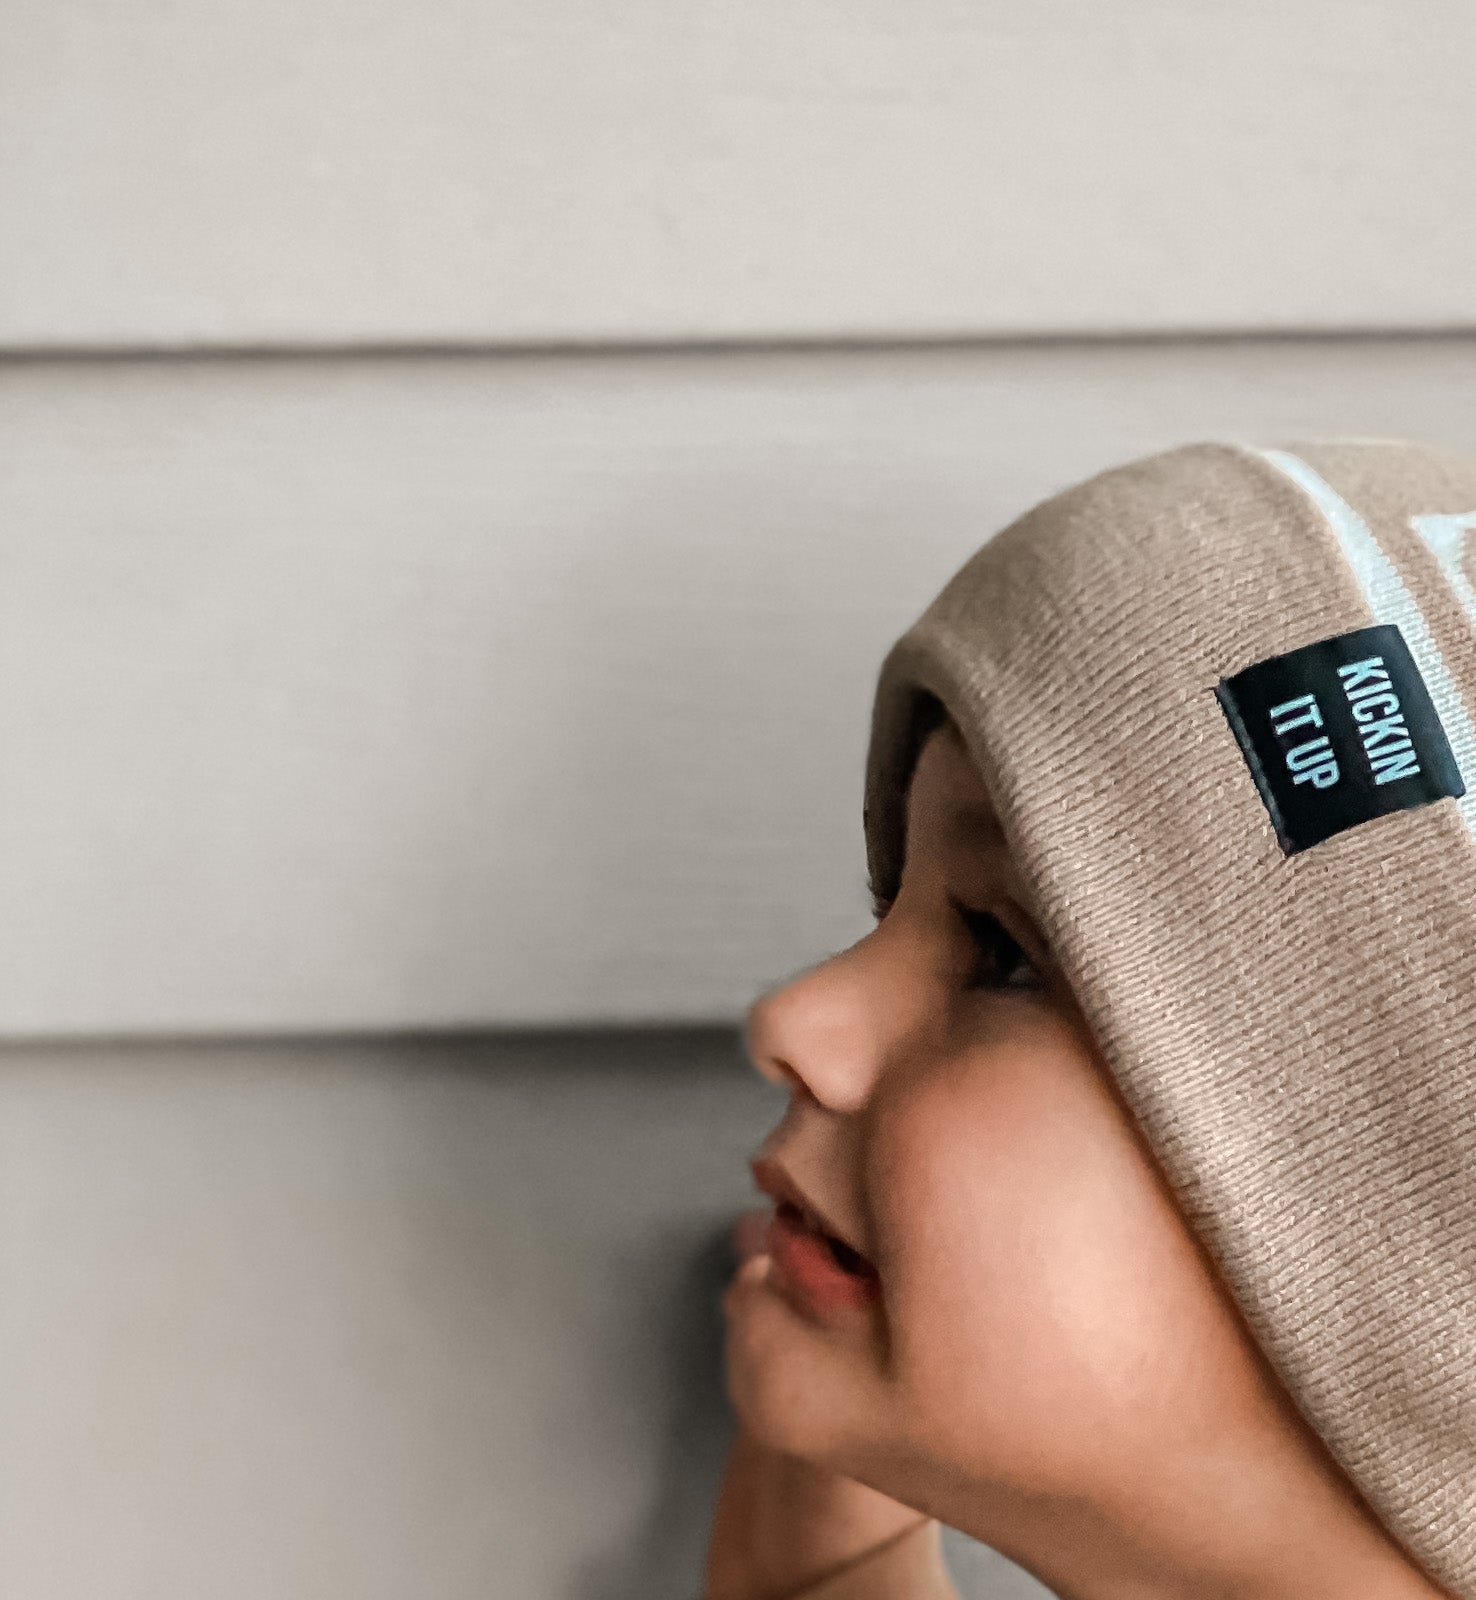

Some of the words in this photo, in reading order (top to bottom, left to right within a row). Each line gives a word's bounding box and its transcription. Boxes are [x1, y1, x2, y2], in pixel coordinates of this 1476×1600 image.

[1270, 692, 1324, 736] IT
[1337, 656, 1421, 786] KICKIN
[1285, 735, 1340, 789] UP
